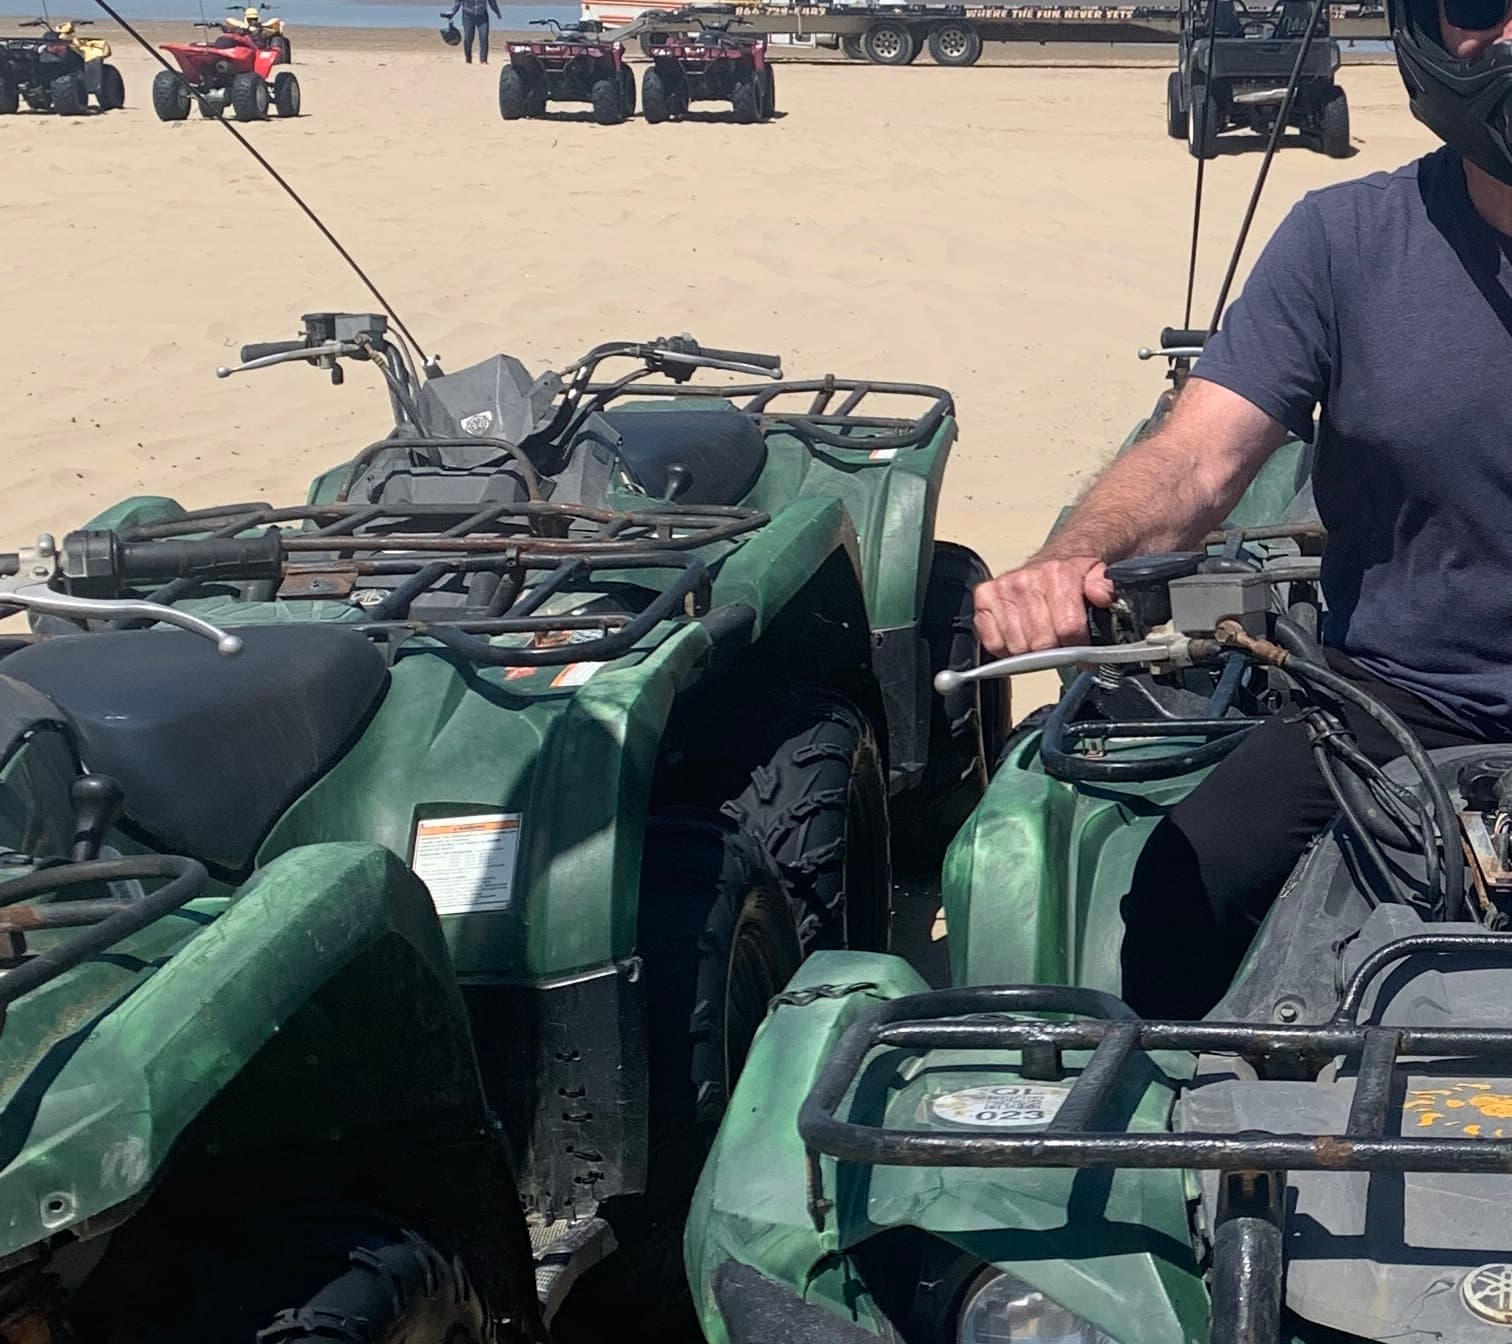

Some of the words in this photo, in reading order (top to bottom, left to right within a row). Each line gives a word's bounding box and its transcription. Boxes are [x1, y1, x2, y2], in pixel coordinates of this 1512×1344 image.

[965, 8, 1008, 18] WHERE
[1011, 8, 1033, 18] THE
[1036, 8, 1061, 18] FUN
[1063, 8, 1103, 18] NEVER
[1105, 8, 1134, 18] SETS
[975, 1109, 1046, 1121] 023
